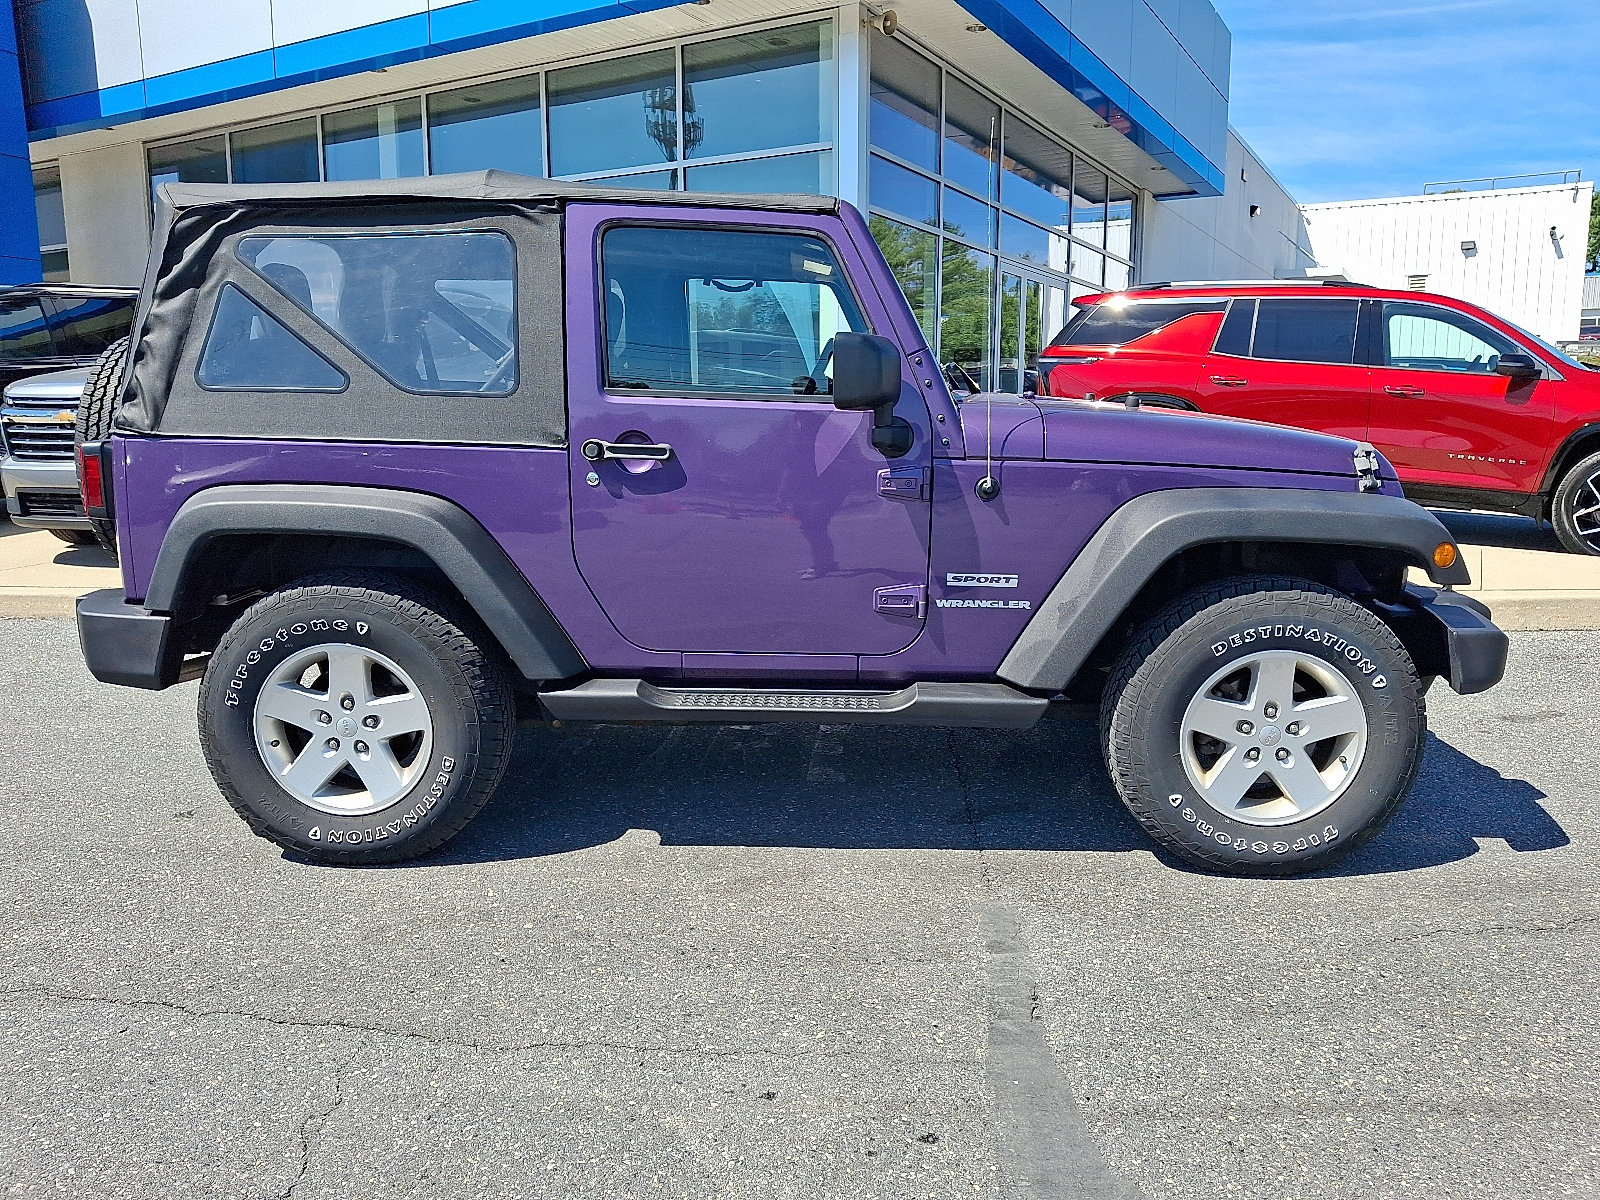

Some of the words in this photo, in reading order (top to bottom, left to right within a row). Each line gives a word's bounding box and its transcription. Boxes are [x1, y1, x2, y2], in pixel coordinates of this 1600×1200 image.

[1447, 453, 1527, 466] TRAVERSE
[950, 574, 1018, 585] SPORT
[935, 599, 1032, 610] WRANGLER
[1210, 623, 1378, 675] DESTINATION
[327, 755, 456, 844] DESTINATION
